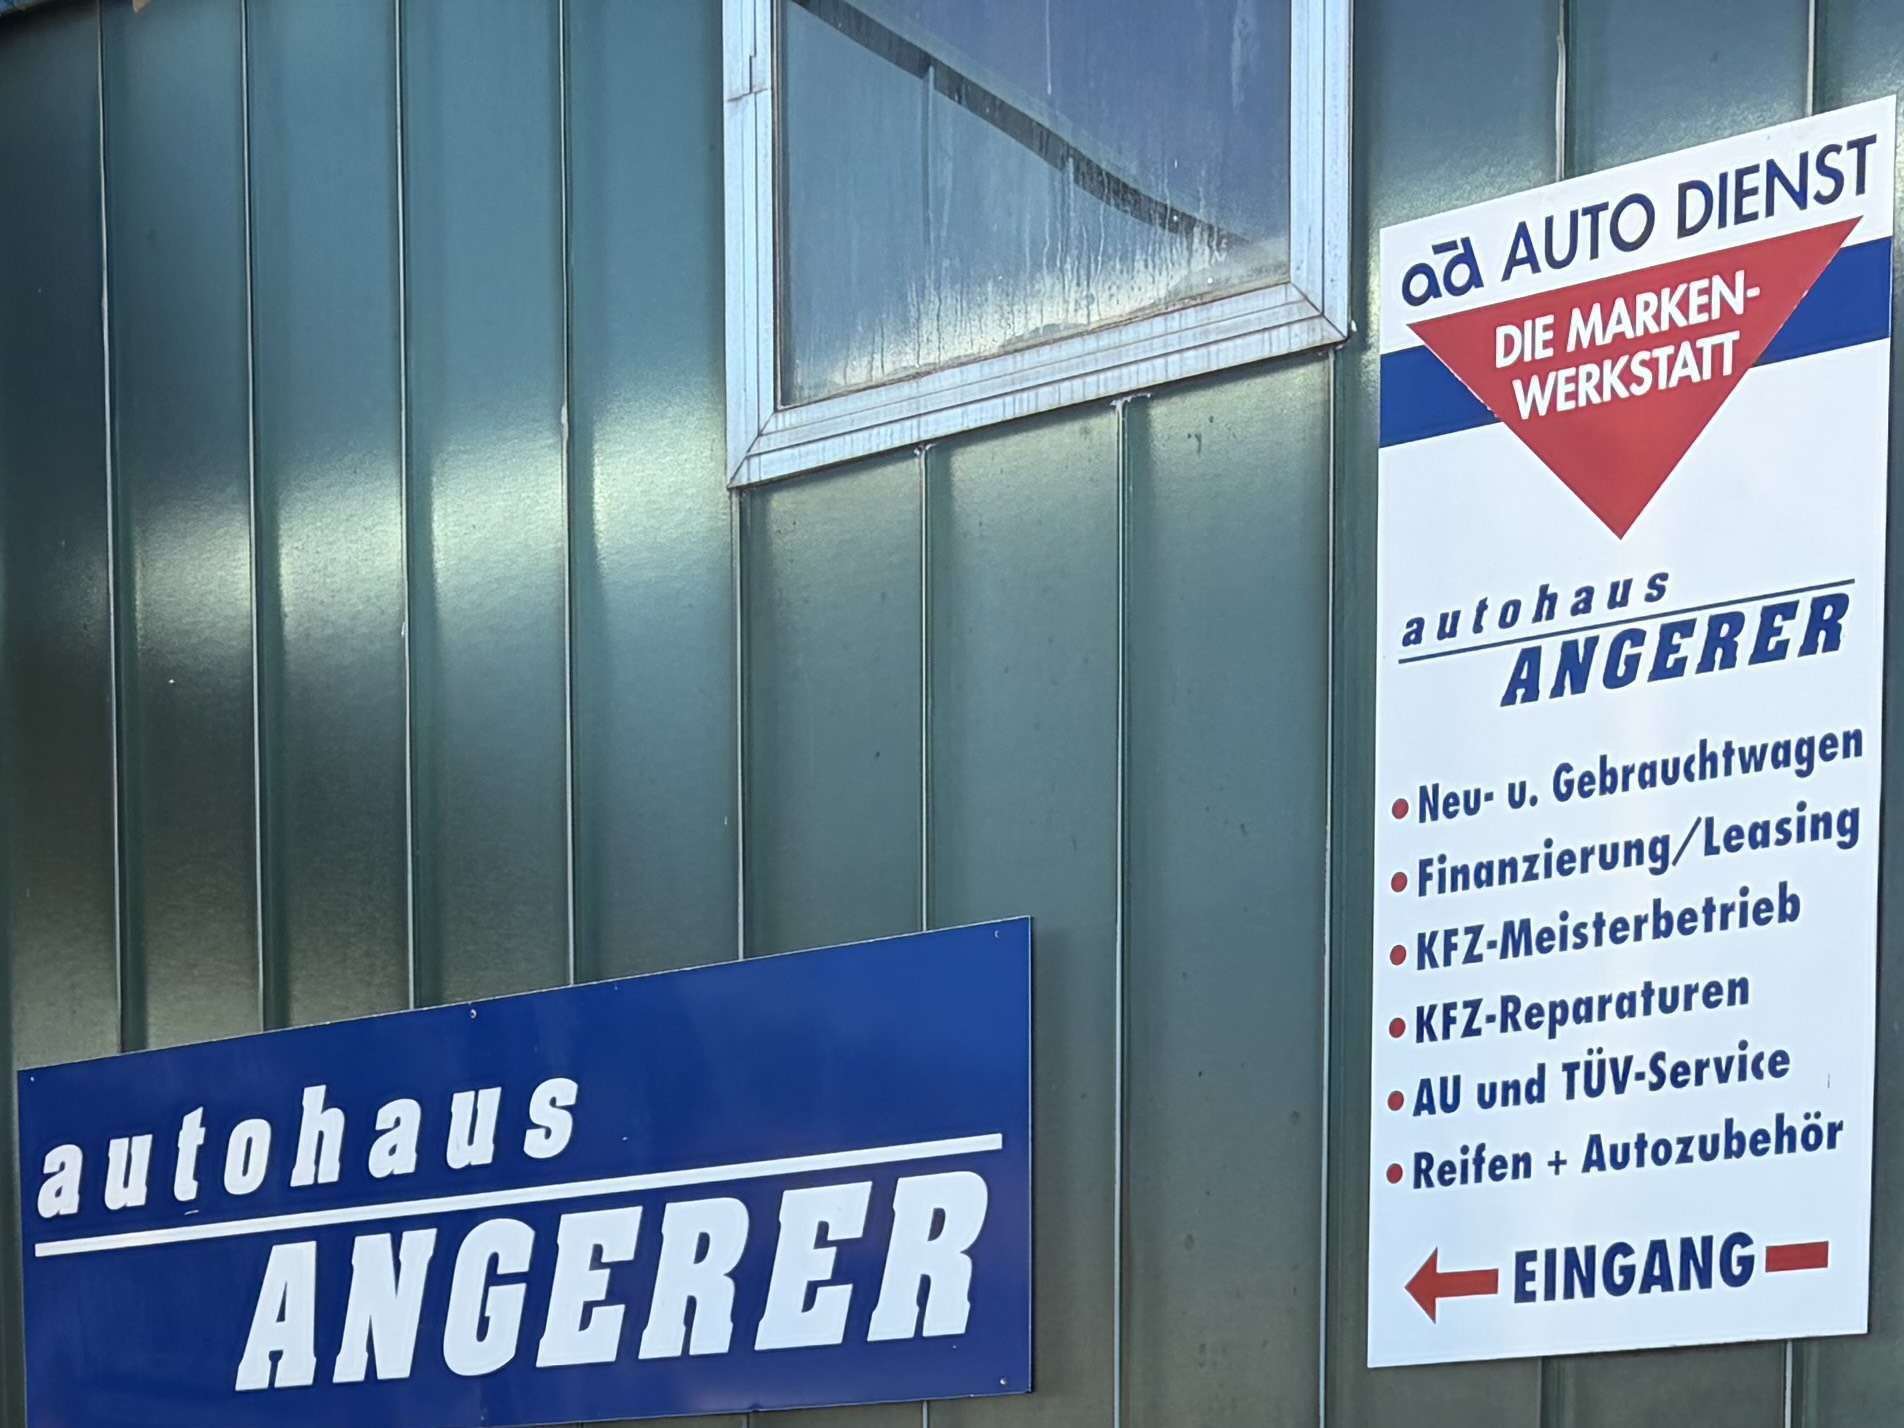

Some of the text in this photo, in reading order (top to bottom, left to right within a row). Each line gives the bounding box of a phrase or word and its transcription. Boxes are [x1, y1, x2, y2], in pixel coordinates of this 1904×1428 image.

[1502, 193, 1656, 282] AUTO
[1677, 135, 1876, 238] DIENST
[1495, 269, 1761, 368] DIE MARKEN-
[1512, 331, 1740, 419] WERKSTATT
[1402, 572, 1669, 648] autohaus
[1500, 592, 1850, 707] ANGERER
[1417, 727, 1863, 824] Neu- u. Gebrauchtwagen
[1417, 800, 1860, 897] Finanzierung/Leasing
[1416, 882, 1800, 971] KFZ-Meisterbetrieb
[1415, 975, 1750, 1043] KFZ-Reparaturen
[1413, 1039, 1790, 1117] AU und TÜV-Service
[36, 1077, 579, 1219] autohaus
[1413, 1111, 1843, 1189] Reifen + Autozubehör
[235, 1171, 988, 1392] ANGERER
[1514, 1231, 1755, 1304] EINGANG
